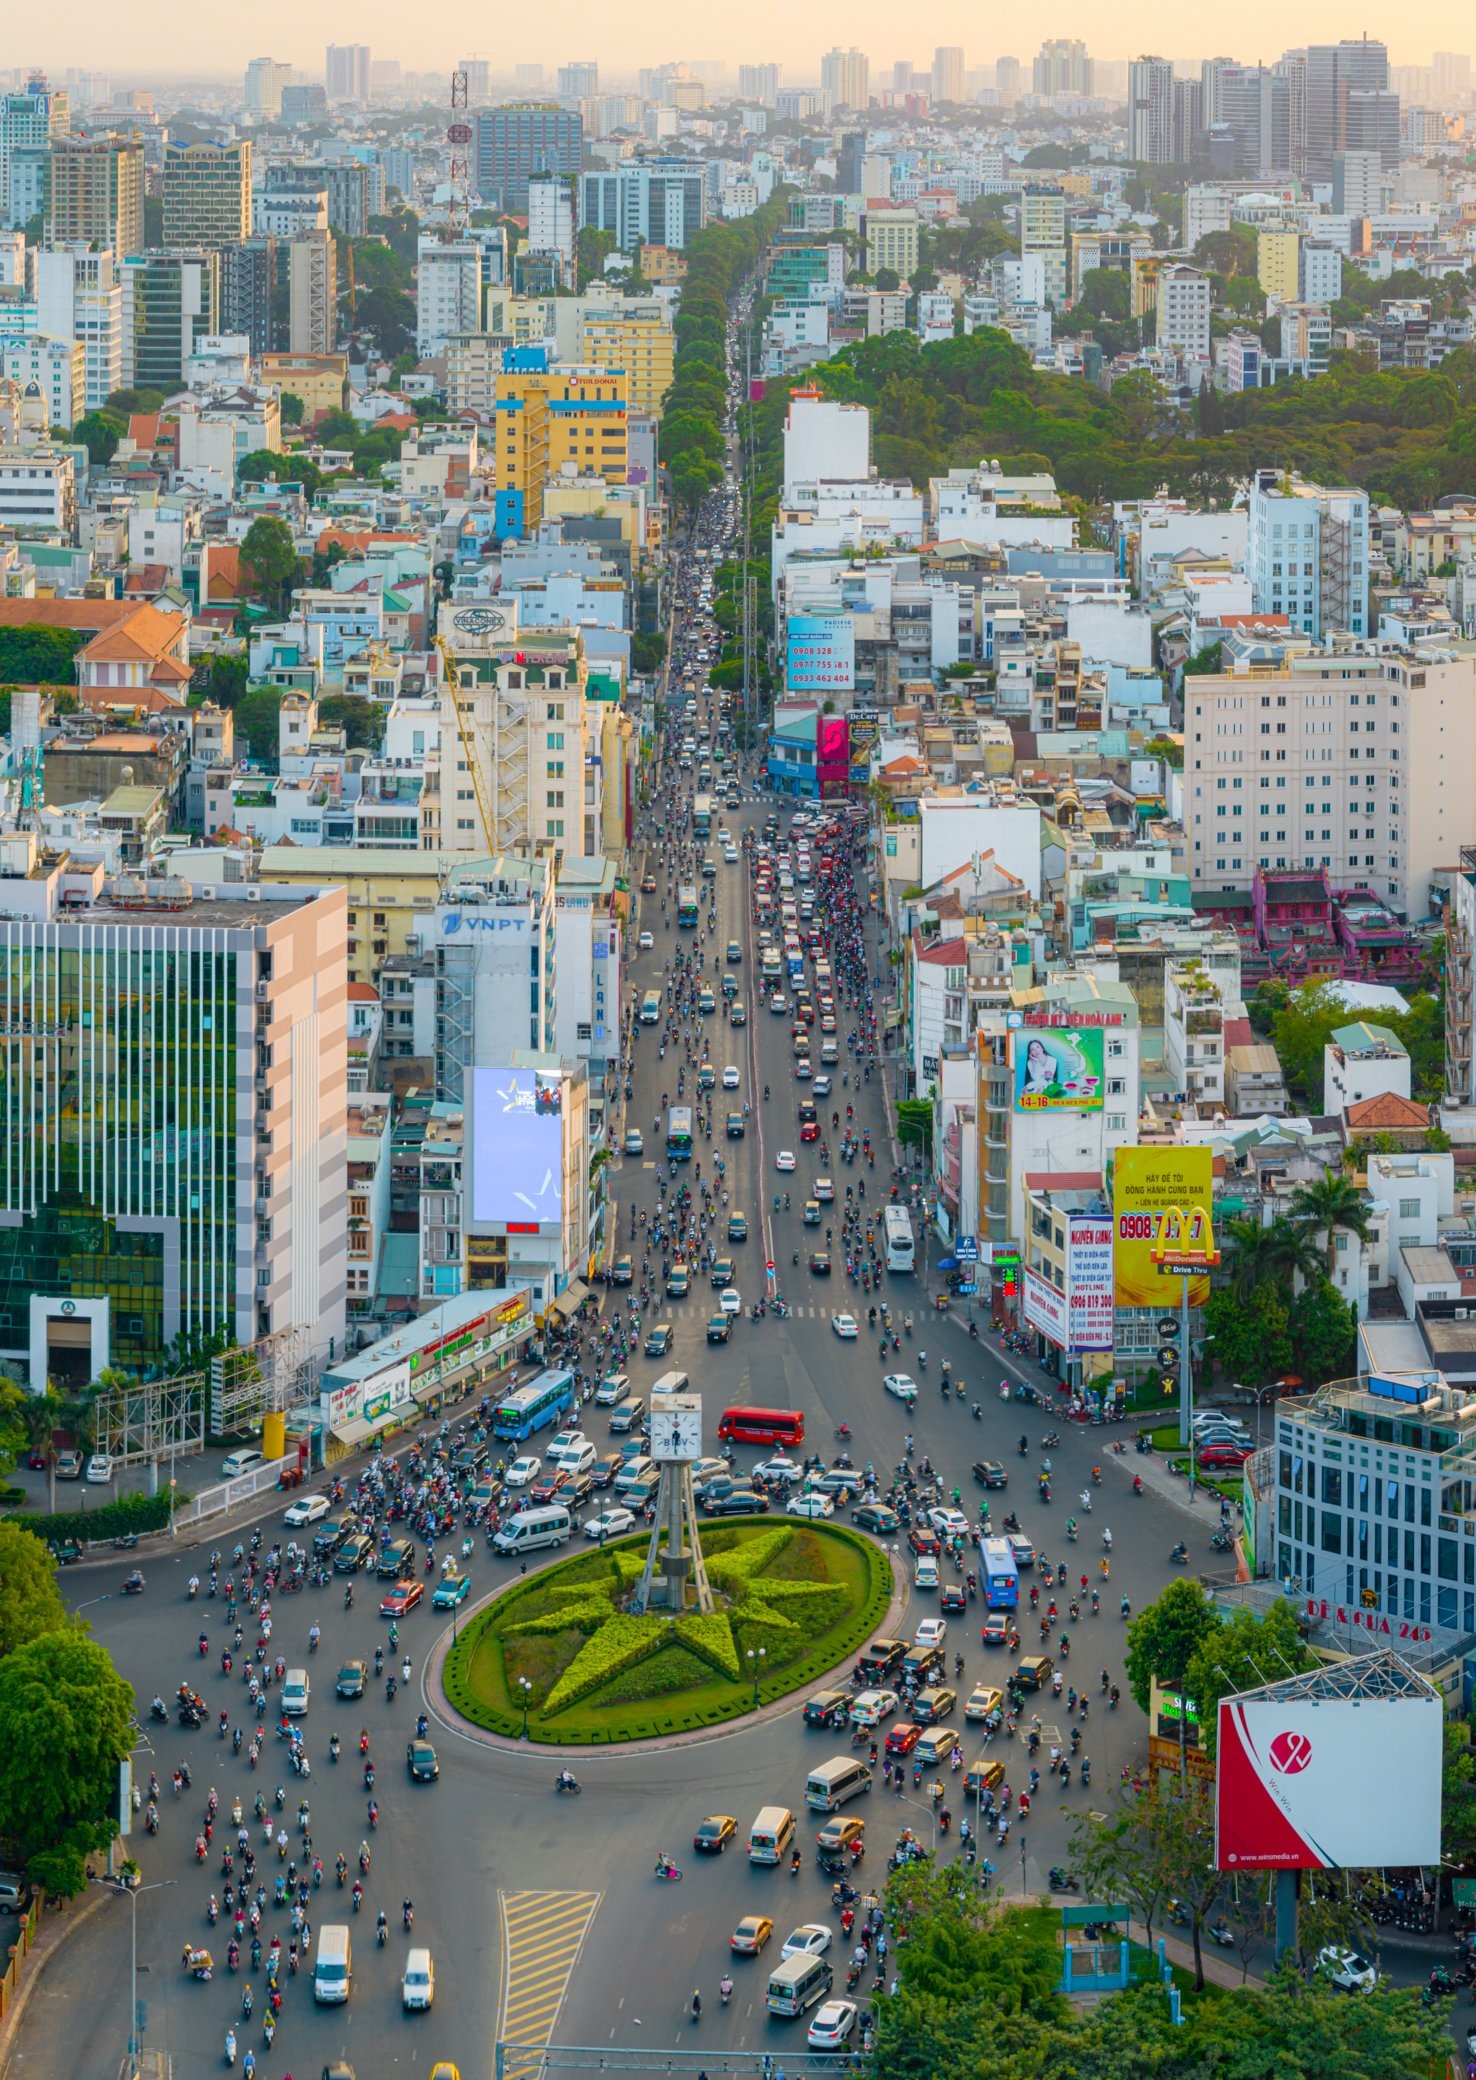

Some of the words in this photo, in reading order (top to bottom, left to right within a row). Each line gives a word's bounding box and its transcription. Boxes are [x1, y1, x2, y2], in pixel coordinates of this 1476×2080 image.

[466, 919, 525, 931] VNPT
[1088, 1295, 1099, 1308] 819
[1400, 1622, 1431, 1642] 245
